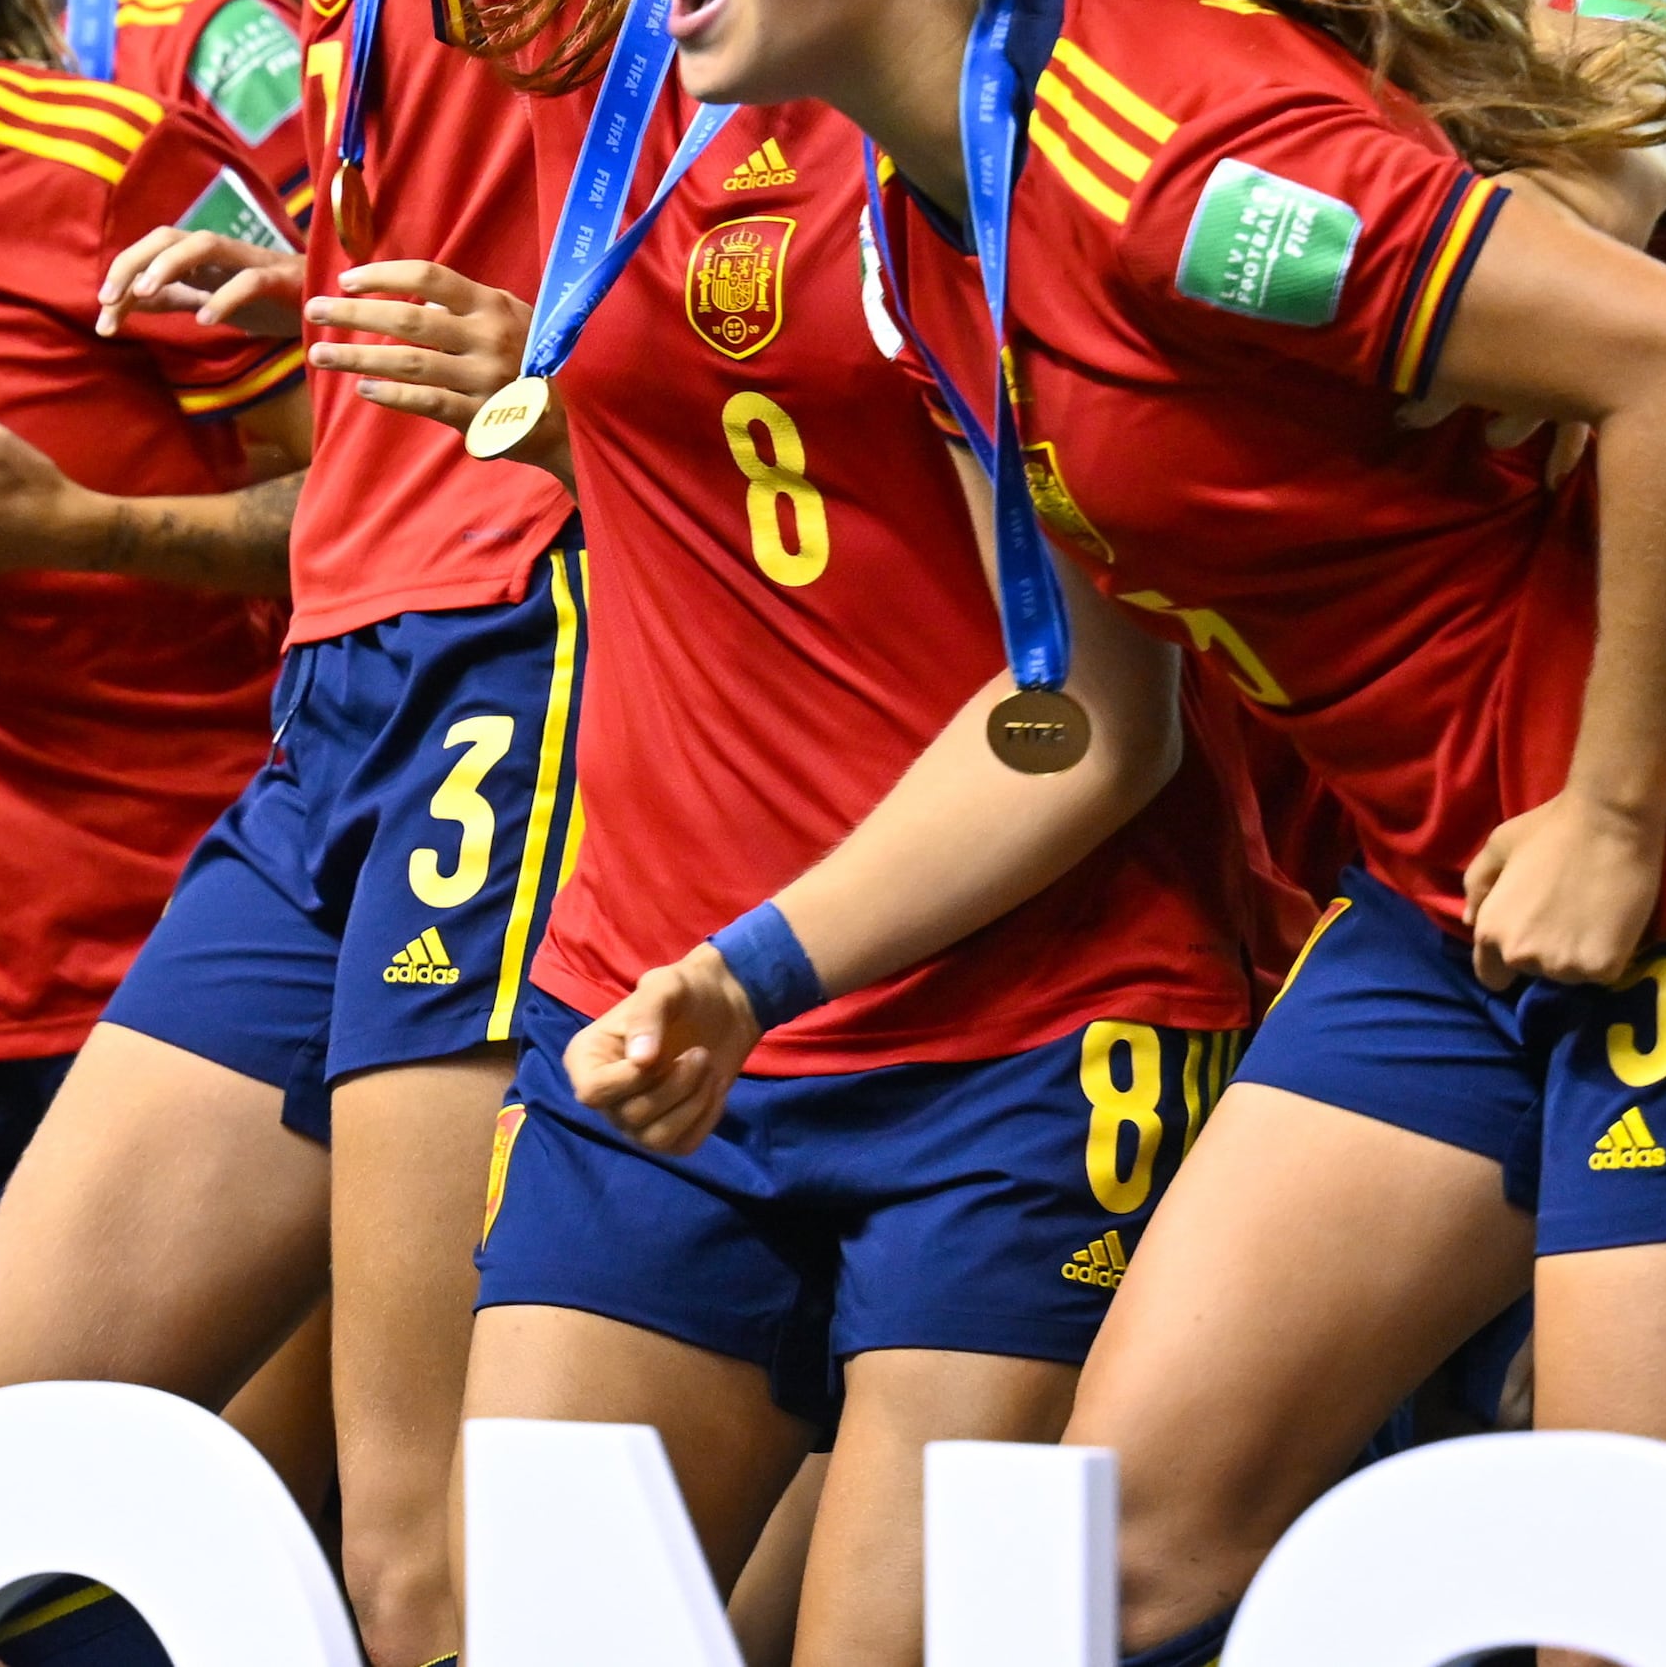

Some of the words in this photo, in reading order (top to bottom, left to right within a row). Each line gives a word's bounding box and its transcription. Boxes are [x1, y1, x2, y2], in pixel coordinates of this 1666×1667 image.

[625, 53, 648, 91] FIFA
[606, 112, 627, 148] FIFA
[589, 168, 611, 205] FIFA
[723, 167, 798, 191] adidas
[572, 225, 594, 259] FIFA
[1284, 201, 1320, 259] FIFA
[483, 406, 528, 427] FIFA
[721, 391, 829, 588] 8
[408, 715, 515, 909] 3
[383, 963, 460, 984] adidas
[1079, 1019, 1163, 1214] 8
[1588, 1146, 1666, 1171] adidas
[1061, 1261, 1126, 1291] adida
